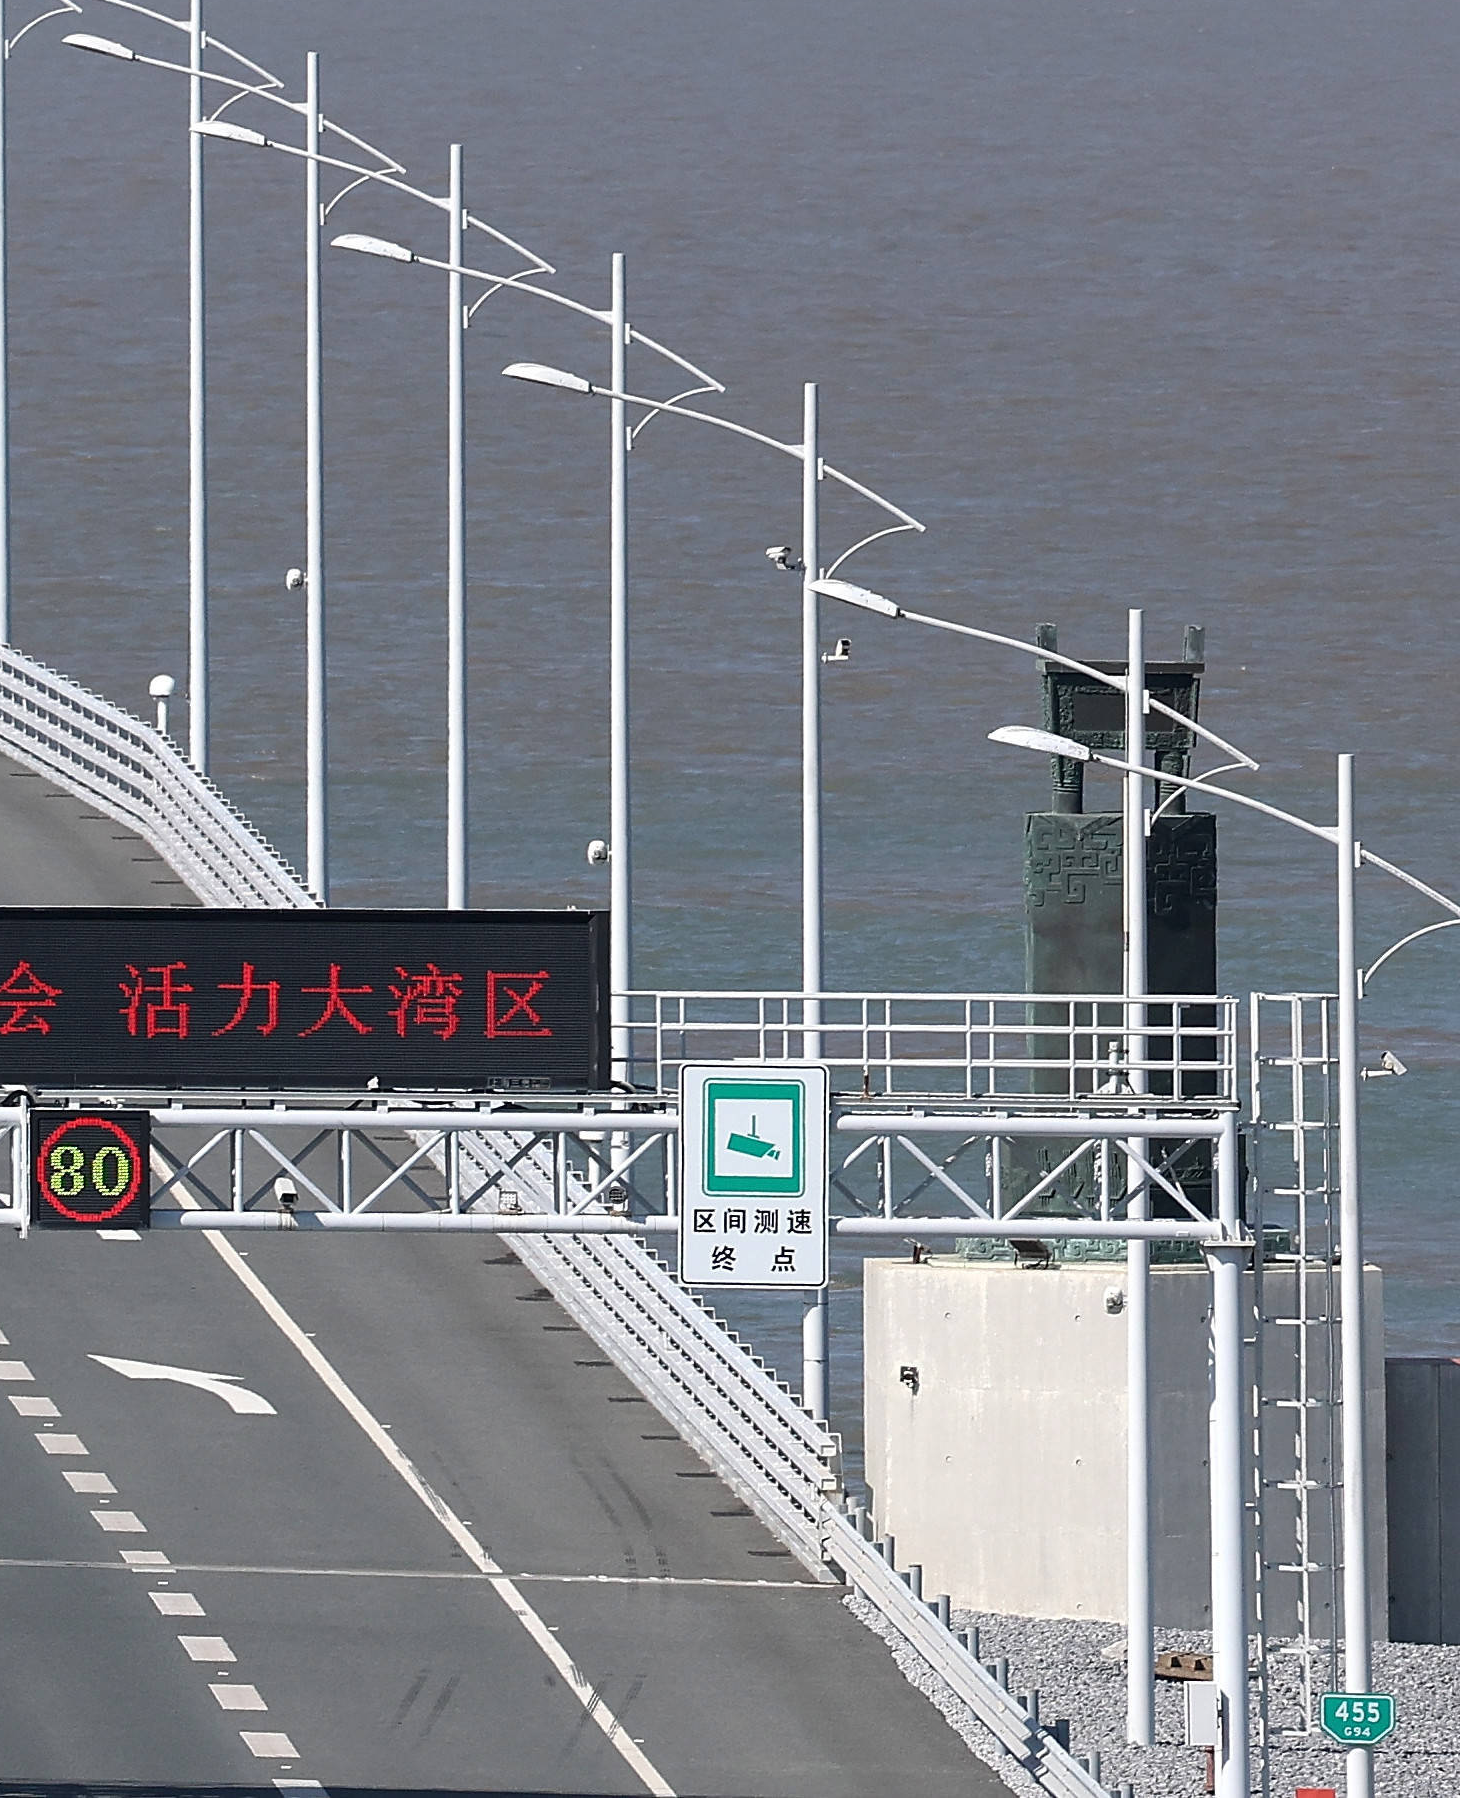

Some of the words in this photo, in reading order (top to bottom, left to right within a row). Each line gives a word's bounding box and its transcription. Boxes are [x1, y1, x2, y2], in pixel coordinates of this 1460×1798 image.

[119, 961, 552, 1040] 活力大湾区
[50, 1146, 129, 1196] 80
[693, 1208, 812, 1234] 区间测速
[711, 1245, 796, 1272] 终点
[1335, 1701, 1380, 1723] 455
[1344, 1727, 1371, 1737] G94
